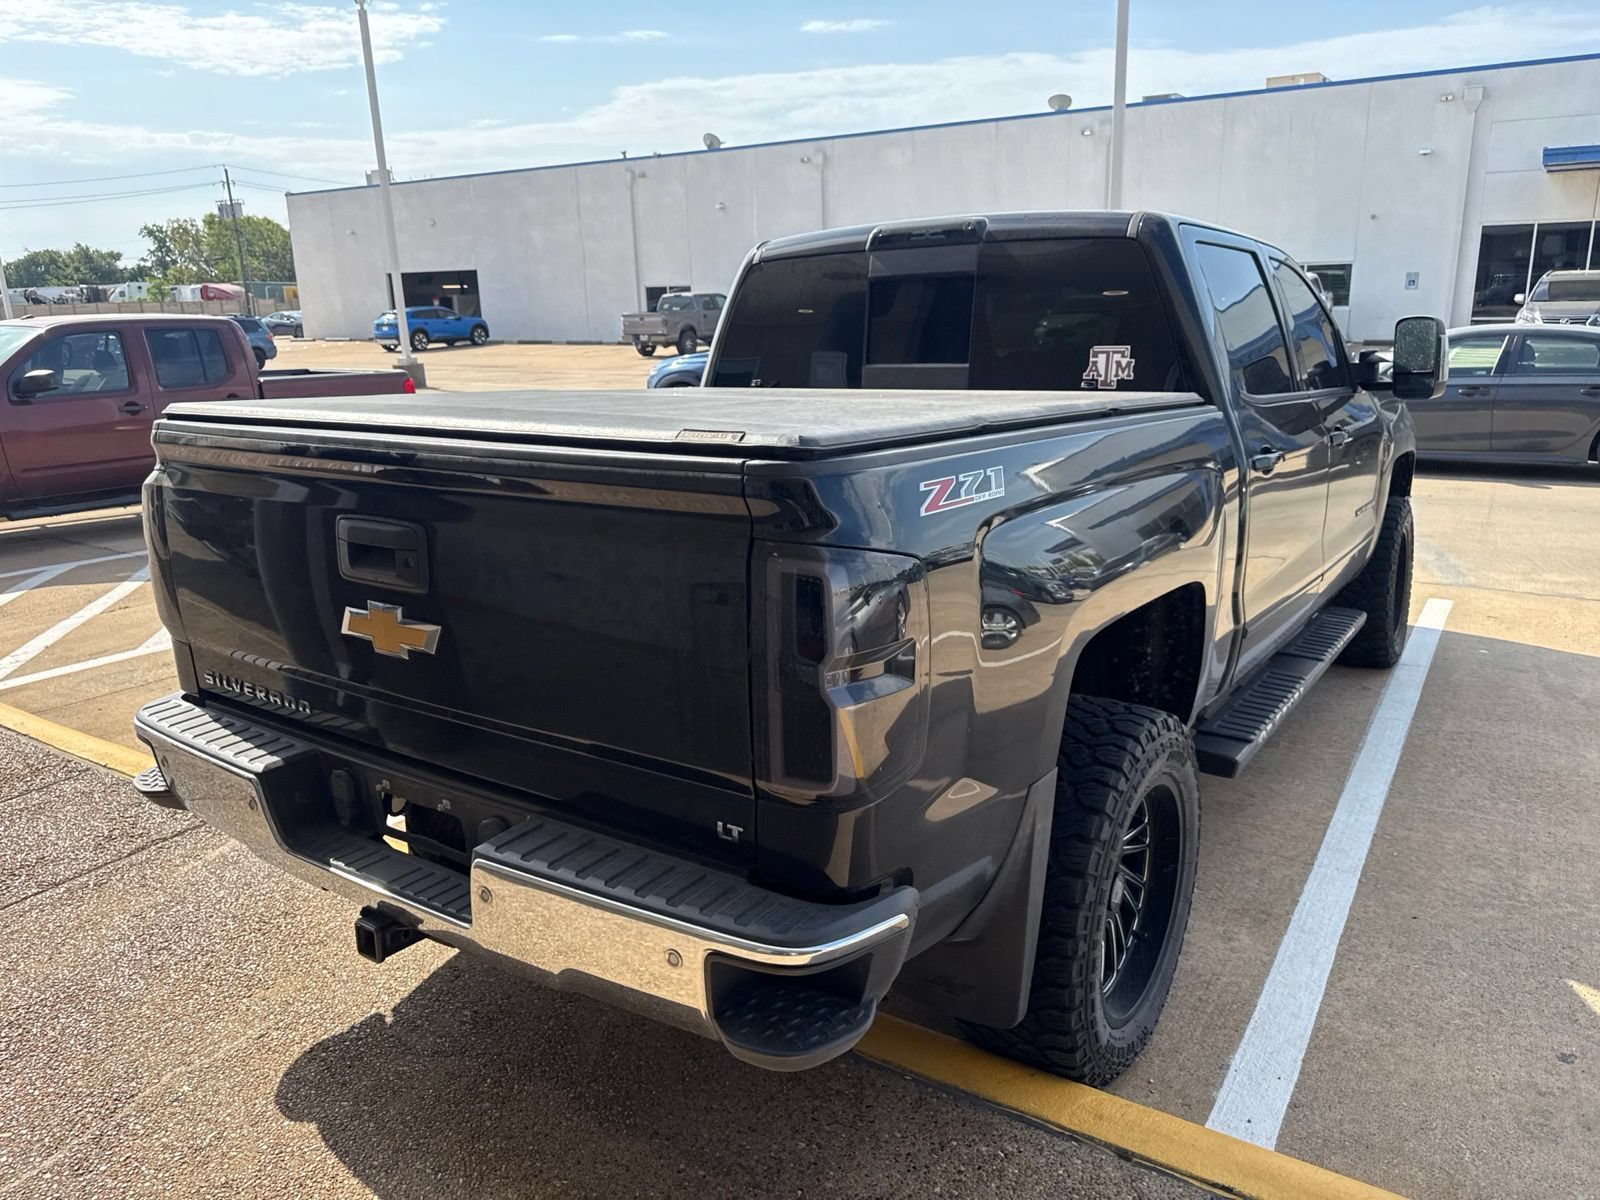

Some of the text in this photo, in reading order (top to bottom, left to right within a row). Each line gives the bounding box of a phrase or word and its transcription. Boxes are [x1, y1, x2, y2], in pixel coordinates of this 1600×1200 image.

[920, 466, 1005, 517] Z71
[204, 668, 312, 714] SILVERADO
[717, 821, 744, 842] LT
